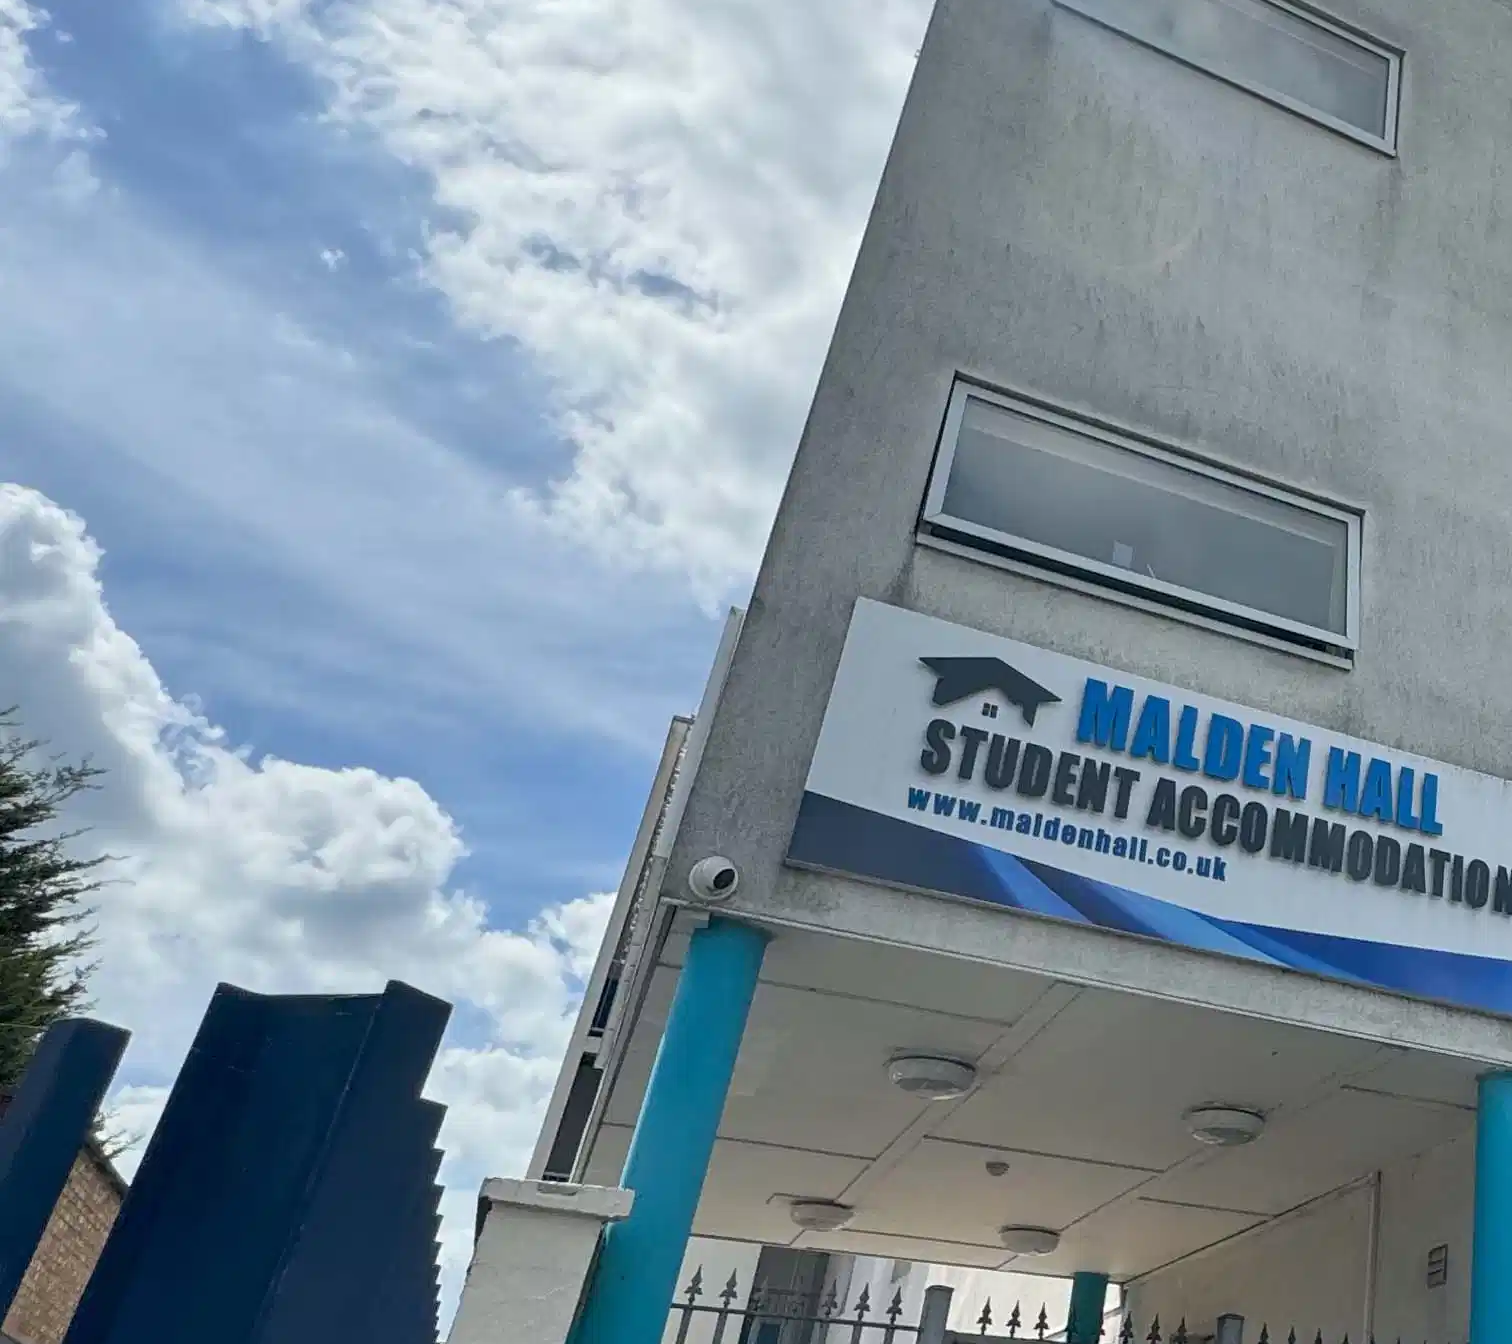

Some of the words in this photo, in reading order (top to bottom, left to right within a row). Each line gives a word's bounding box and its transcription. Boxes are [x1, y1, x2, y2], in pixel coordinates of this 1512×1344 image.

[920, 718, 1140, 820] STUDENT
[1076, 677, 1311, 800] MALDEN
[1323, 745, 1443, 836] HALL
[907, 786, 1227, 882] www.maldenhall.co.uk
